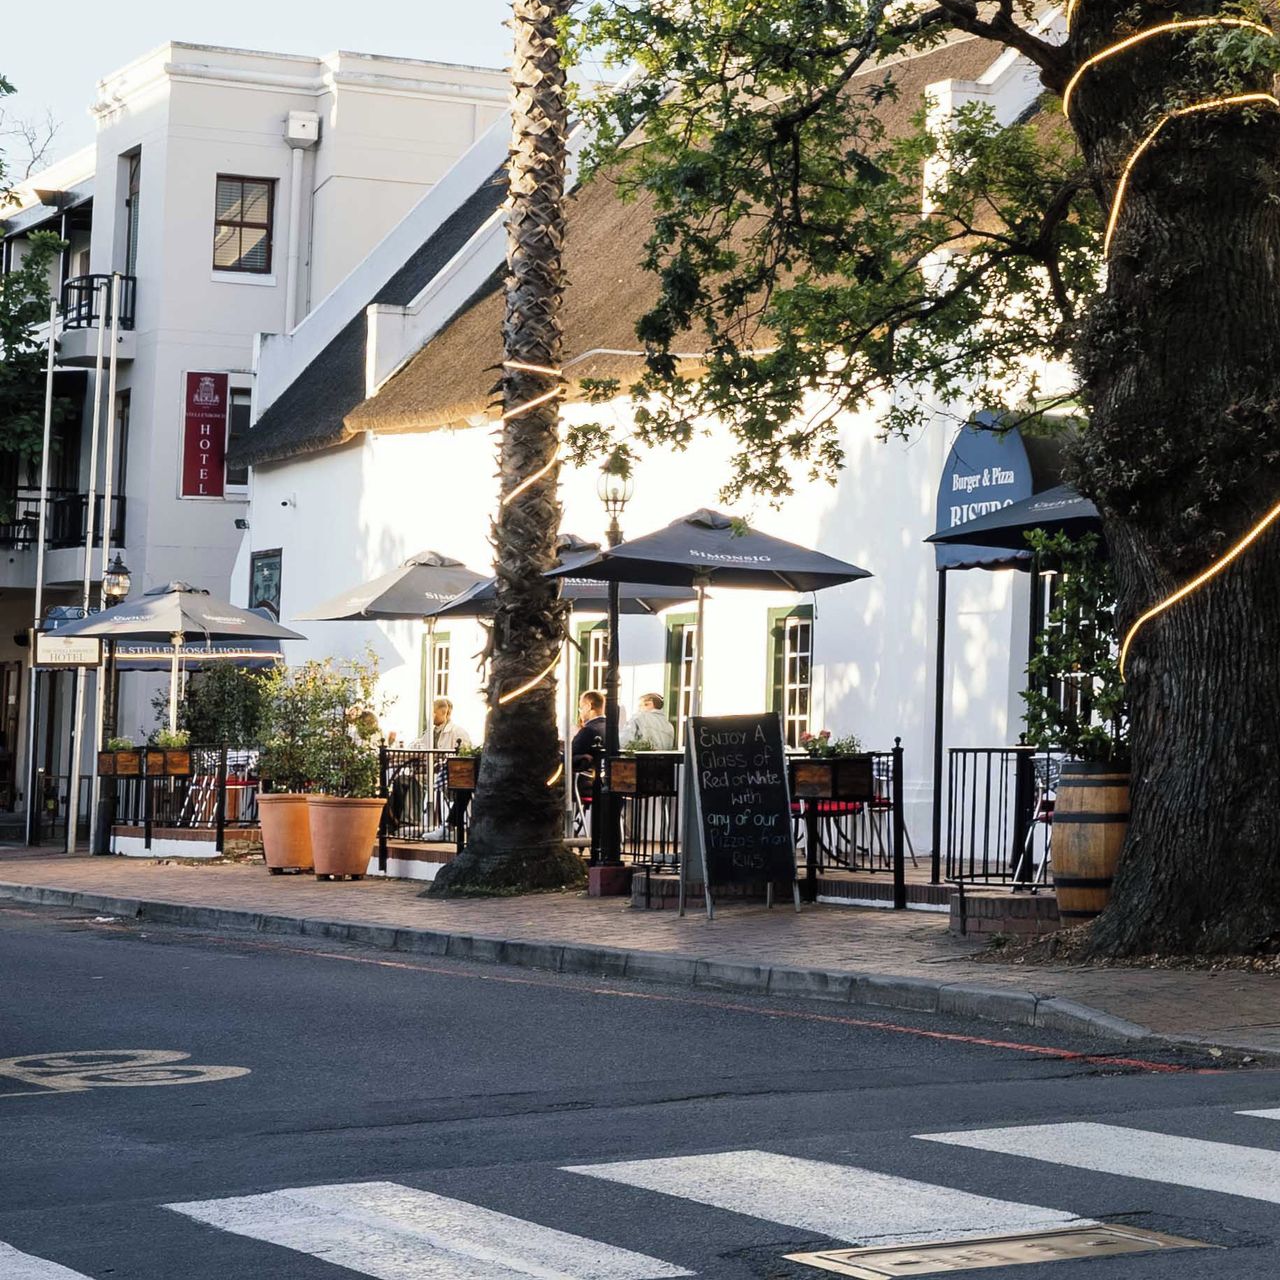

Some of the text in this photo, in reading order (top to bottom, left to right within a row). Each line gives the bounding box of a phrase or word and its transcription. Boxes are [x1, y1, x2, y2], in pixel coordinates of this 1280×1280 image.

[199, 423, 211, 495] HOTEL
[952, 467, 1015, 493] Burger & Pizza
[700, 724, 766, 747] ENJOY A
[701, 744, 773, 769] Glass of
[702, 770, 729, 790] Red
[732, 774, 746, 786] or
[731, 788, 761, 806] with
[707, 808, 780, 836] any of our
